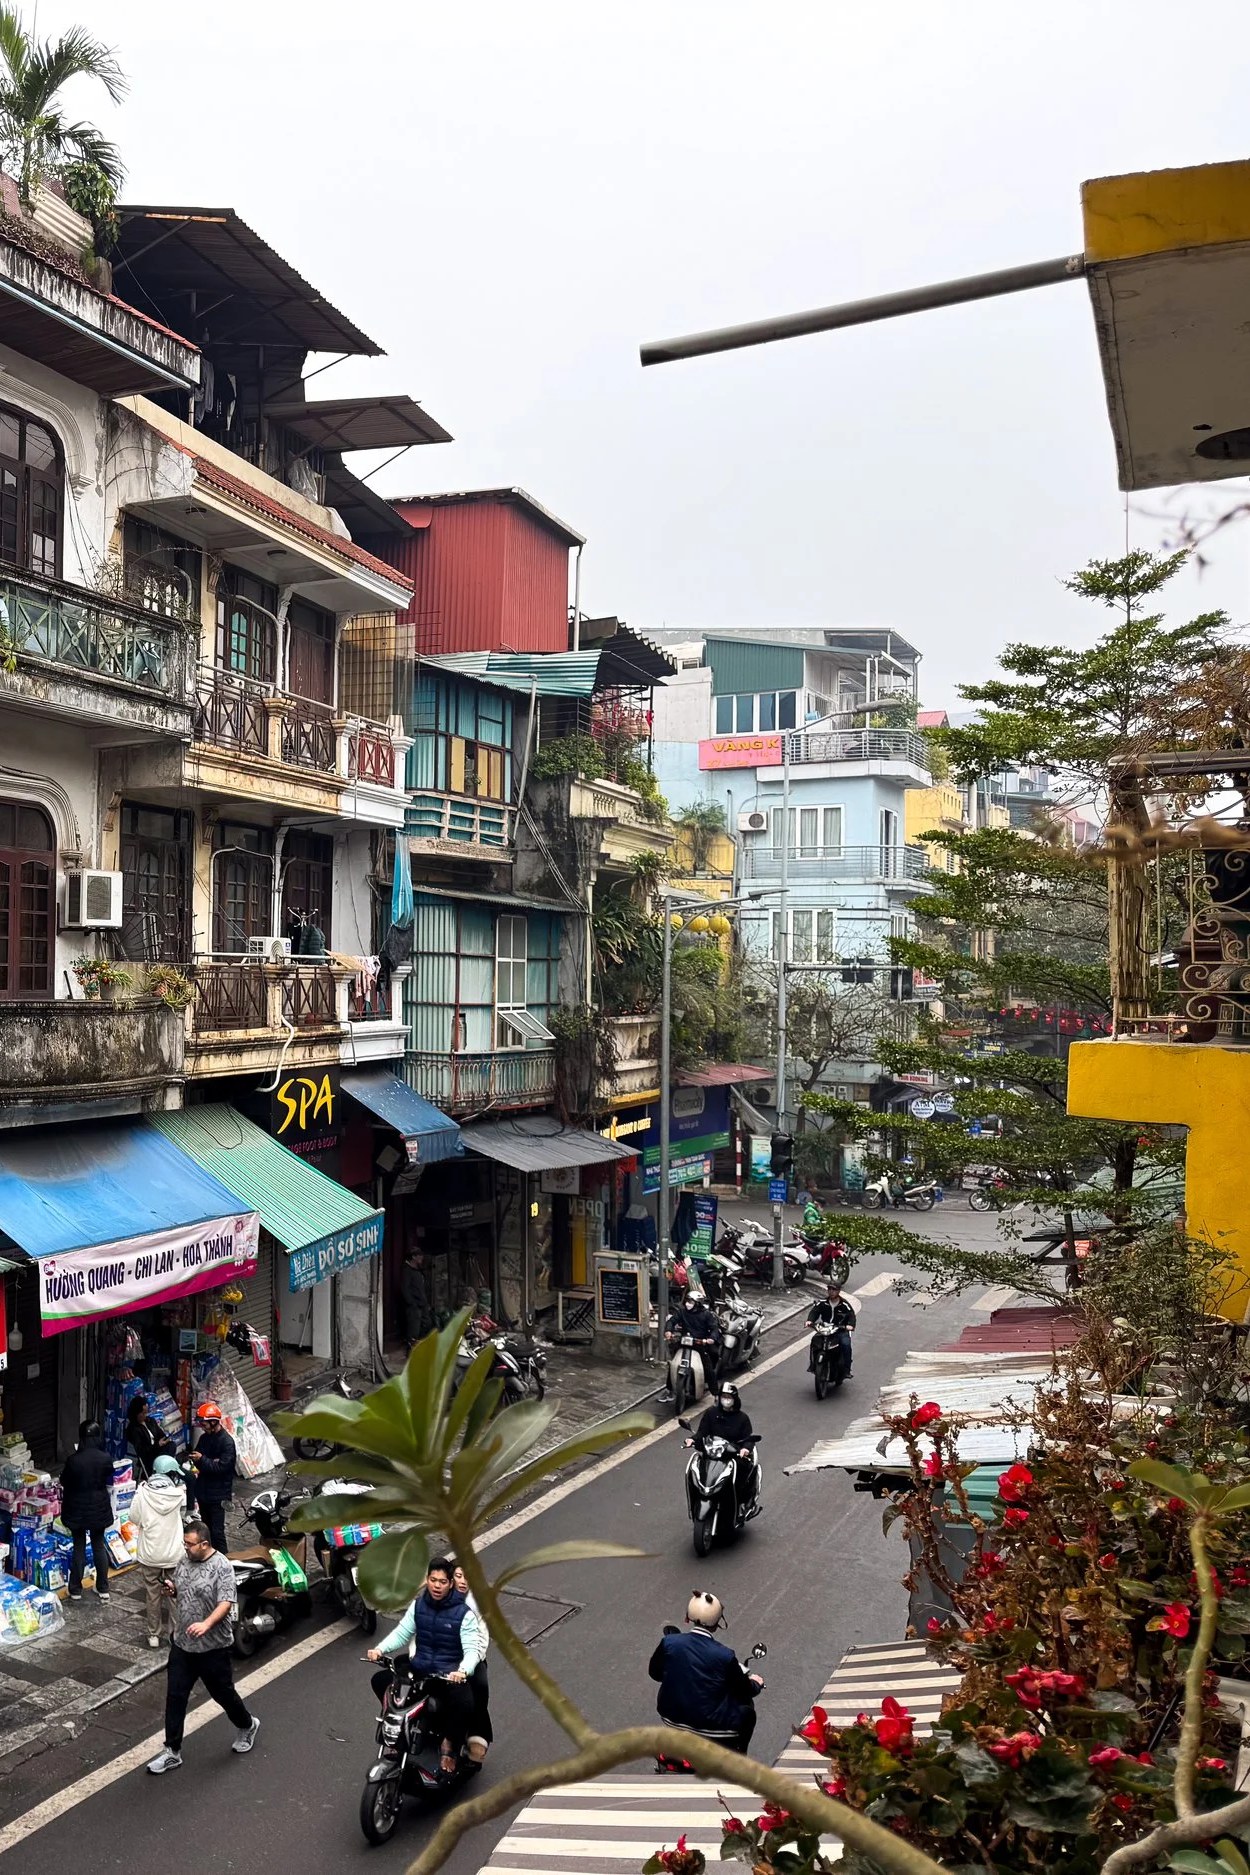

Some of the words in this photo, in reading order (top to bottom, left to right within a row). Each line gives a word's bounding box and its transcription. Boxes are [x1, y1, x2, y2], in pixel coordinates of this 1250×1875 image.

[712, 741, 763, 752] VÀNG
[277, 1073, 336, 1134] SPA
[87, 1261, 125, 1295] QUANG
[135, 1256, 153, 1280] CHI
[155, 1249, 175, 1274] LAN
[182, 1244, 202, 1268] HOA
[203, 1235, 233, 1262] THÀNH
[318, 1237, 335, 1271] ĐỒ
[337, 1233, 354, 1260] SƠ
